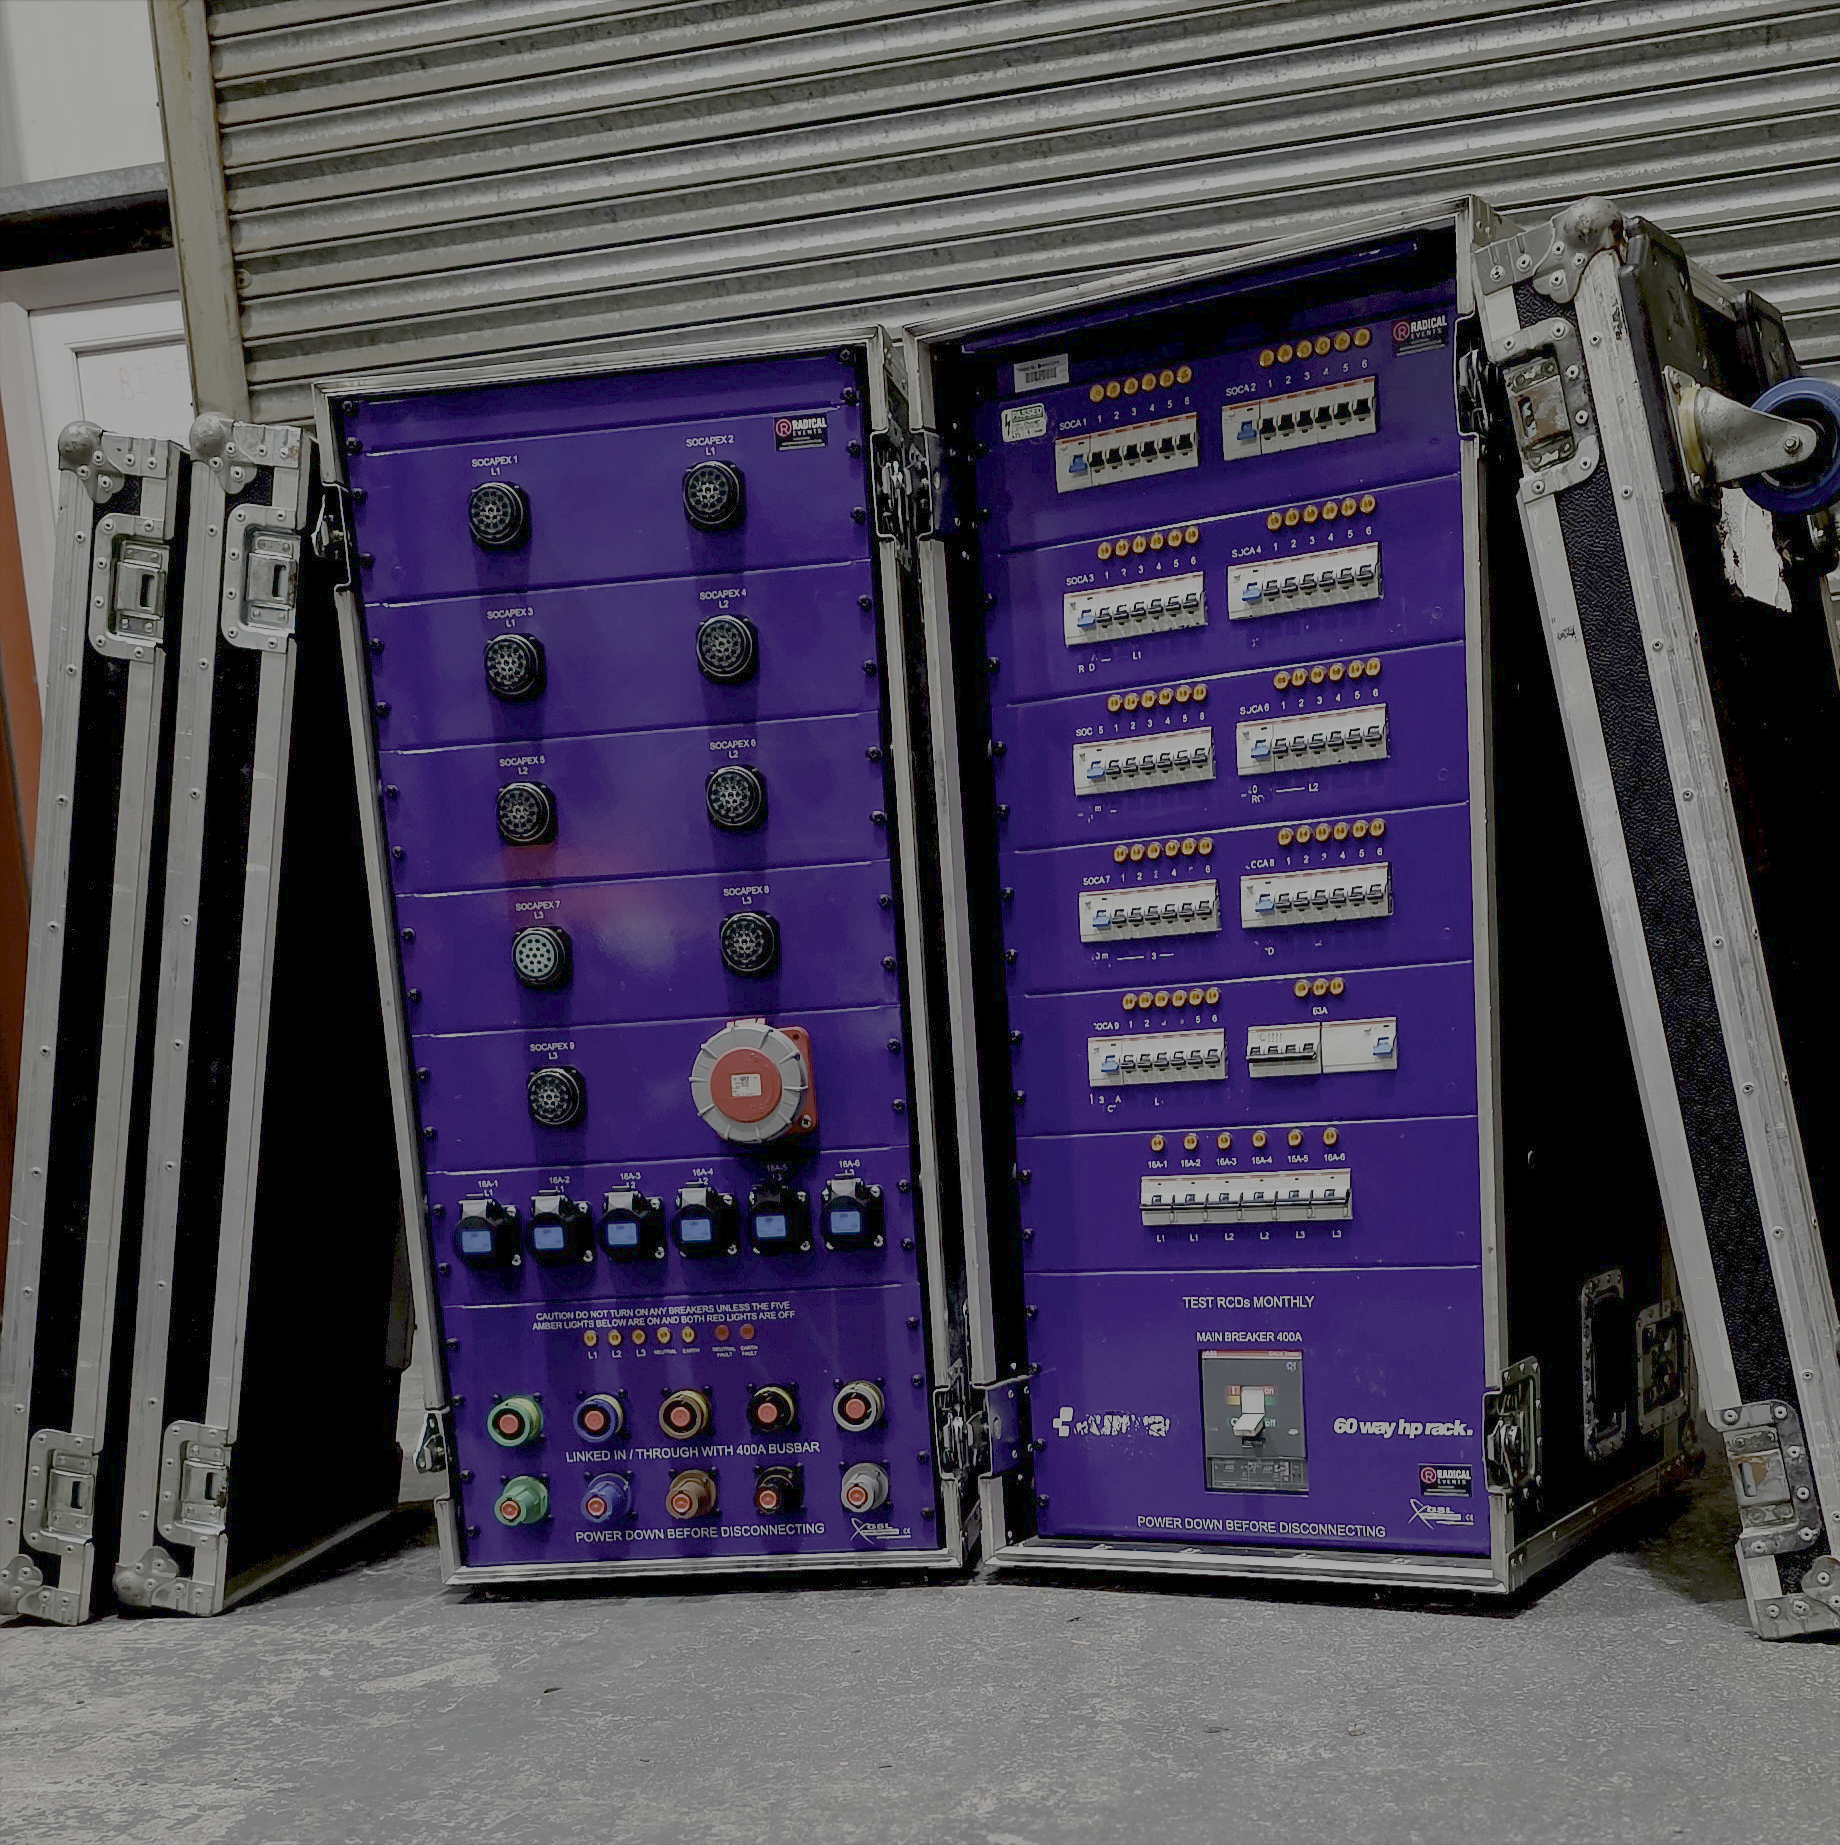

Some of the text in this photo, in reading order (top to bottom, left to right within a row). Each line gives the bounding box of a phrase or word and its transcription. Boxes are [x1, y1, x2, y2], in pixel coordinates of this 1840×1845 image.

[1411, 315, 1447, 334] RADICAL
[1226, 384, 1250, 397] SOCA
[1011, 406, 1044, 421] PASSED
[792, 417, 827, 431] RADICAL
[1059, 419, 1082, 431] SOCA
[686, 435, 727, 447] SOCAPEX
[705, 447, 715, 455] L1
[472, 456, 512, 467] SOCAPEX
[491, 467, 500, 476] L1
[1066, 575, 1088, 586] SOCA
[699, 589, 740, 600] SOCAPEX
[719, 600, 729, 609] L2
[487, 608, 527, 619] SOCAPEX
[506, 619, 515, 627] L1
[1133, 651, 1141, 660] L1
[710, 740, 750, 751] SOCAPEX
[729, 750, 739, 759] L2
[499, 757, 539, 767] SOCAPEX
[518, 766, 528, 775] L2
[1309, 783, 1319, 792] L2
[1083, 876, 1105, 886] SOCA
[723, 886, 763, 896] SOCAPEX
[742, 896, 752, 905] L3
[516, 901, 554, 911] SOCAPEX
[534, 911, 544, 919] L3
[1313, 1006, 1328, 1016] 63A
[530, 1042, 568, 1052] SOCAPEX
[548, 1052, 558, 1060] L3
[1148, 1160, 1167, 1169] 16A-1
[1216, 1158, 1237, 1166] 16A-3
[1287, 1154, 1309, 1163] 16A-5
[1324, 1153, 1345, 1162] 16A-6
[620, 1172, 641, 1180] 16A-3
[692, 1168, 713, 1176] 16A-4
[549, 1176, 570, 1184] 16A-2
[1156, 1230, 1342, 1243] L1 L1 L2 L2 L3 L3
[1182, 1296, 1314, 1309] TEST RCDs MONTHLY
[536, 1301, 790, 1321] CAUTION DO NOT TURN ON ANY BREAKERS UNLESS THE FIVE
[532, 1310, 796, 1331] AMBER LIGHTS BELOW ARE ON AND BOTH RED LIGHTS ARE OFF
[1197, 1332, 1302, 1342] MAIN BREAKER 400A
[588, 1351, 597, 1359] L1
[612, 1350, 622, 1358] L2
[636, 1349, 646, 1357] L3
[1264, 1418, 1277, 1427] off
[1334, 1418, 1473, 1439] 60 way hp rack.
[566, 1450, 610, 1463] LINKED
[614, 1449, 626, 1461] IN
[635, 1447, 698, 1460] THROUGH
[701, 1445, 733, 1457] WITH
[736, 1444, 766, 1456] 400A
[769, 1442, 820, 1454] BUSBAR
[1437, 1470, 1471, 1480] RADICAL
[1138, 1516, 1386, 1538] POWER DOWN BEFORE DISCONNECTING
[576, 1523, 825, 1543] POWER DOWN BEFORE DISCONNECTING
